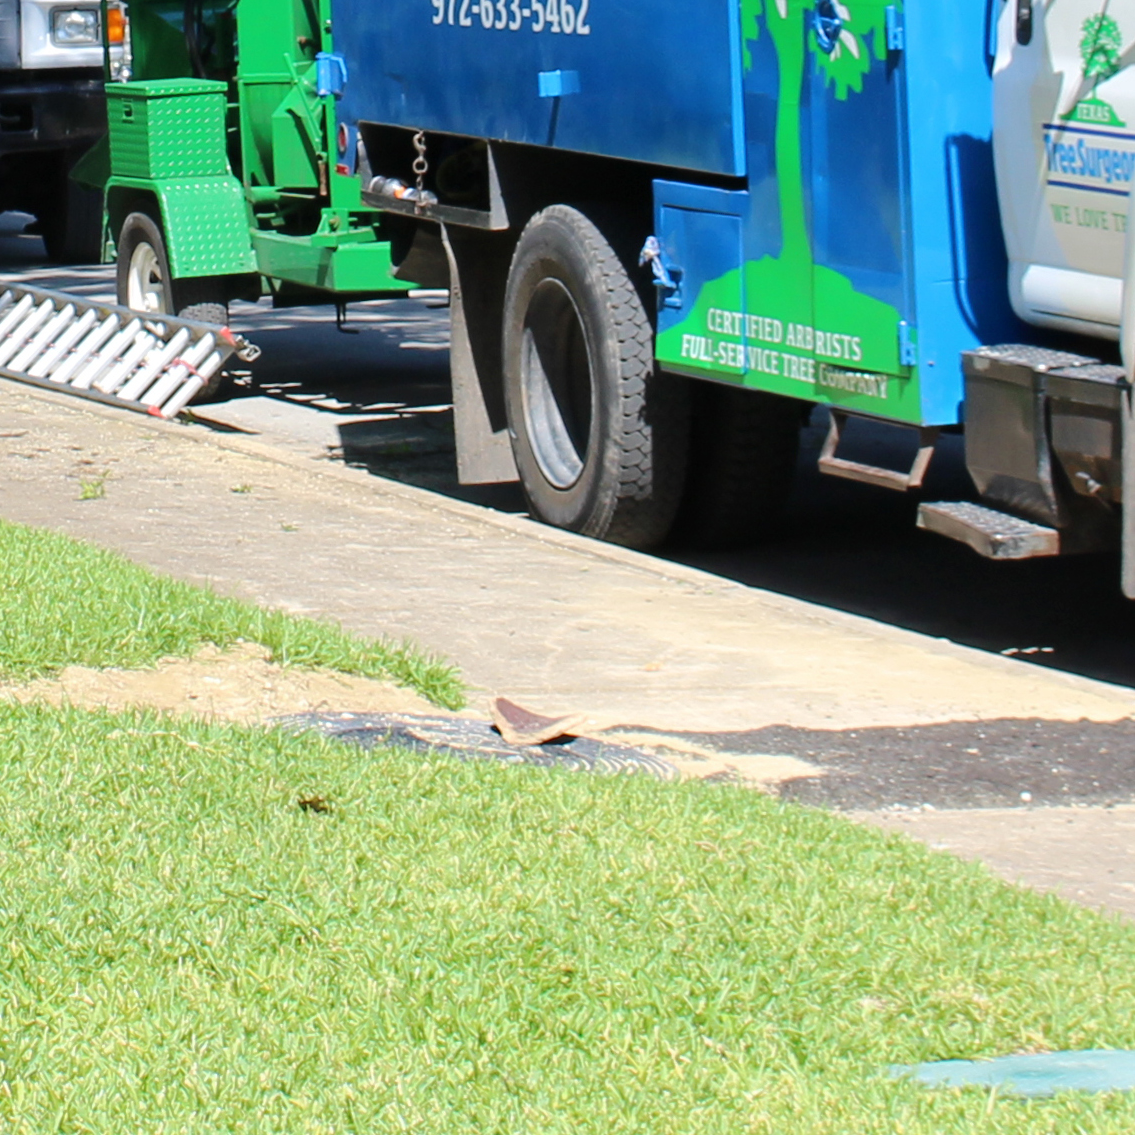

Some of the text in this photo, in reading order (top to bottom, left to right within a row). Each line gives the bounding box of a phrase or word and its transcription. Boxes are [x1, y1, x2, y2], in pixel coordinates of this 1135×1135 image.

[1076, 103, 1111, 123] TEXAS
[1050, 203, 1072, 225] WE
[1074, 207, 1109, 231] LOVE
[707, 308, 783, 343] CERTIFIED
[781, 353, 816, 383] TREE
